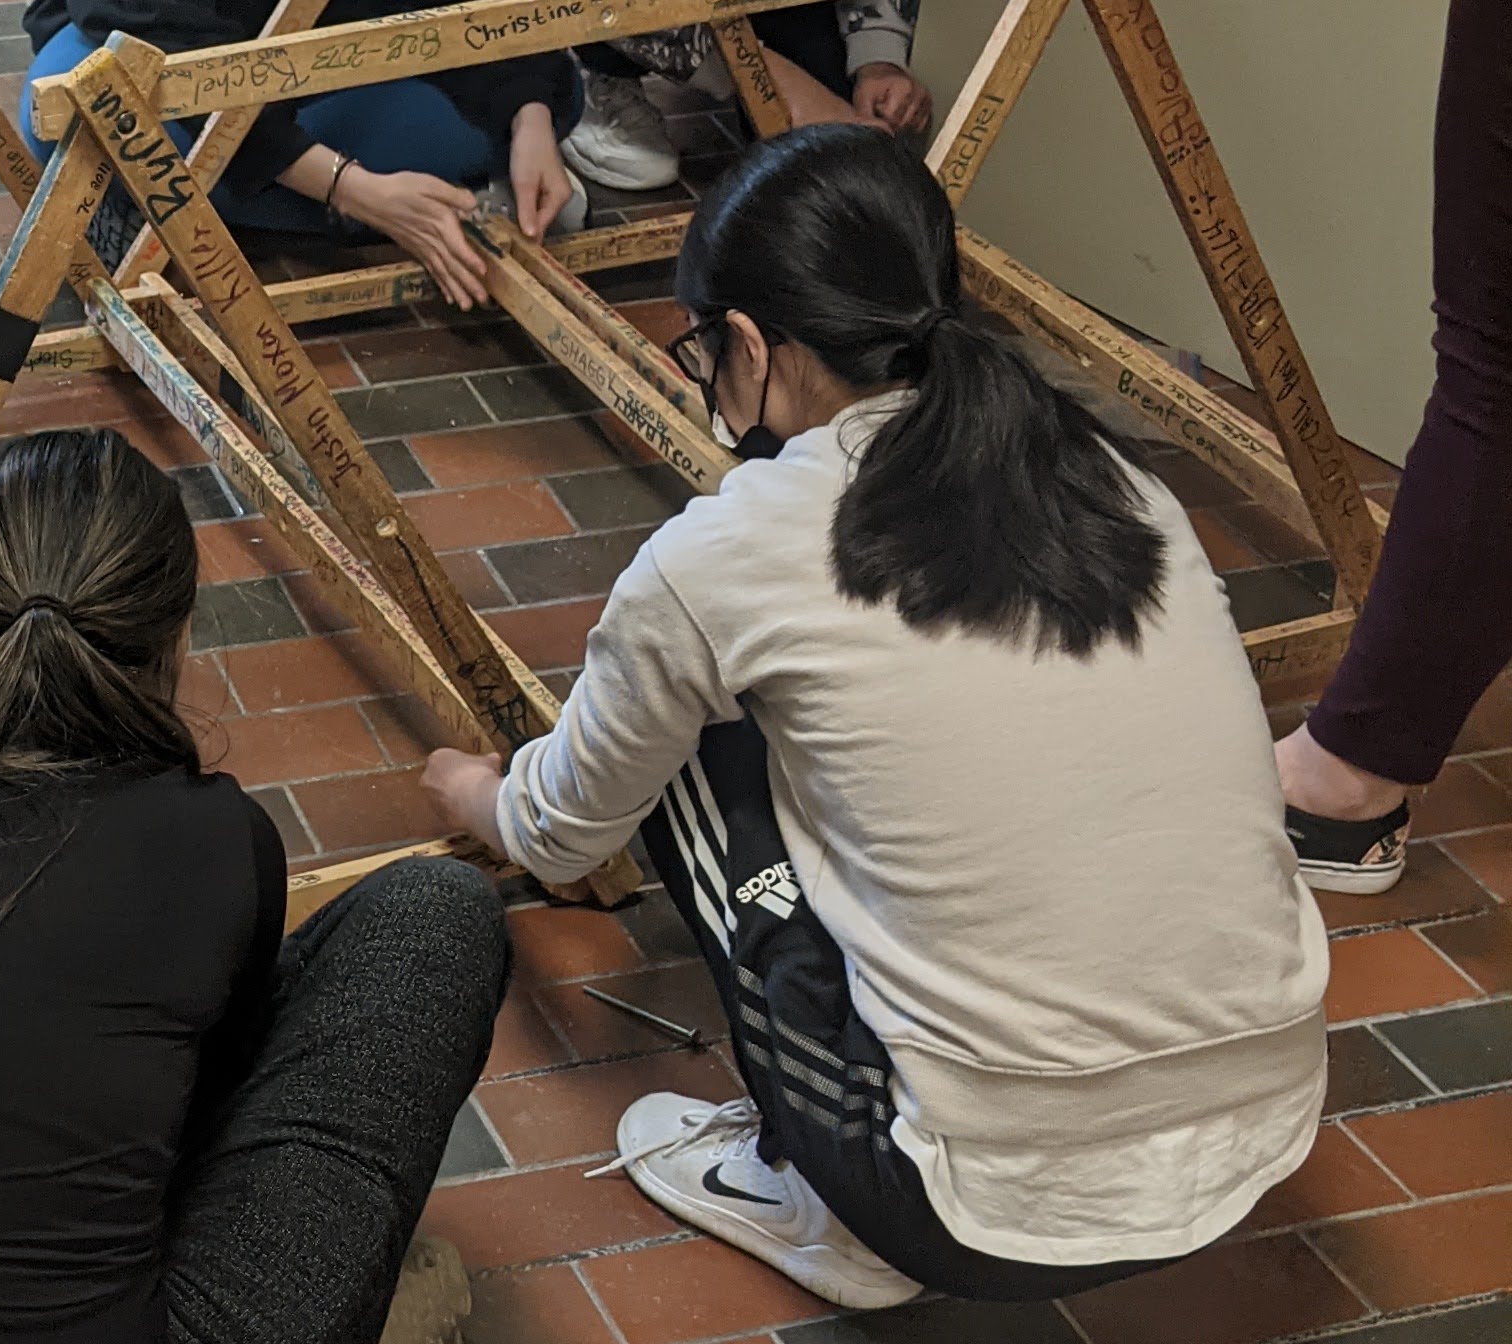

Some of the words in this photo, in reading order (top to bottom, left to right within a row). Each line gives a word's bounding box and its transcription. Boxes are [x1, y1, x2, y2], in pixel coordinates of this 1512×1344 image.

[190, 54, 308, 108] Rachel
[89, 161, 112, 190] 2011
[1114, 369, 1182, 428] Brent
[297, 407, 361, 486] Justin
[732, 859, 795, 903] didas
